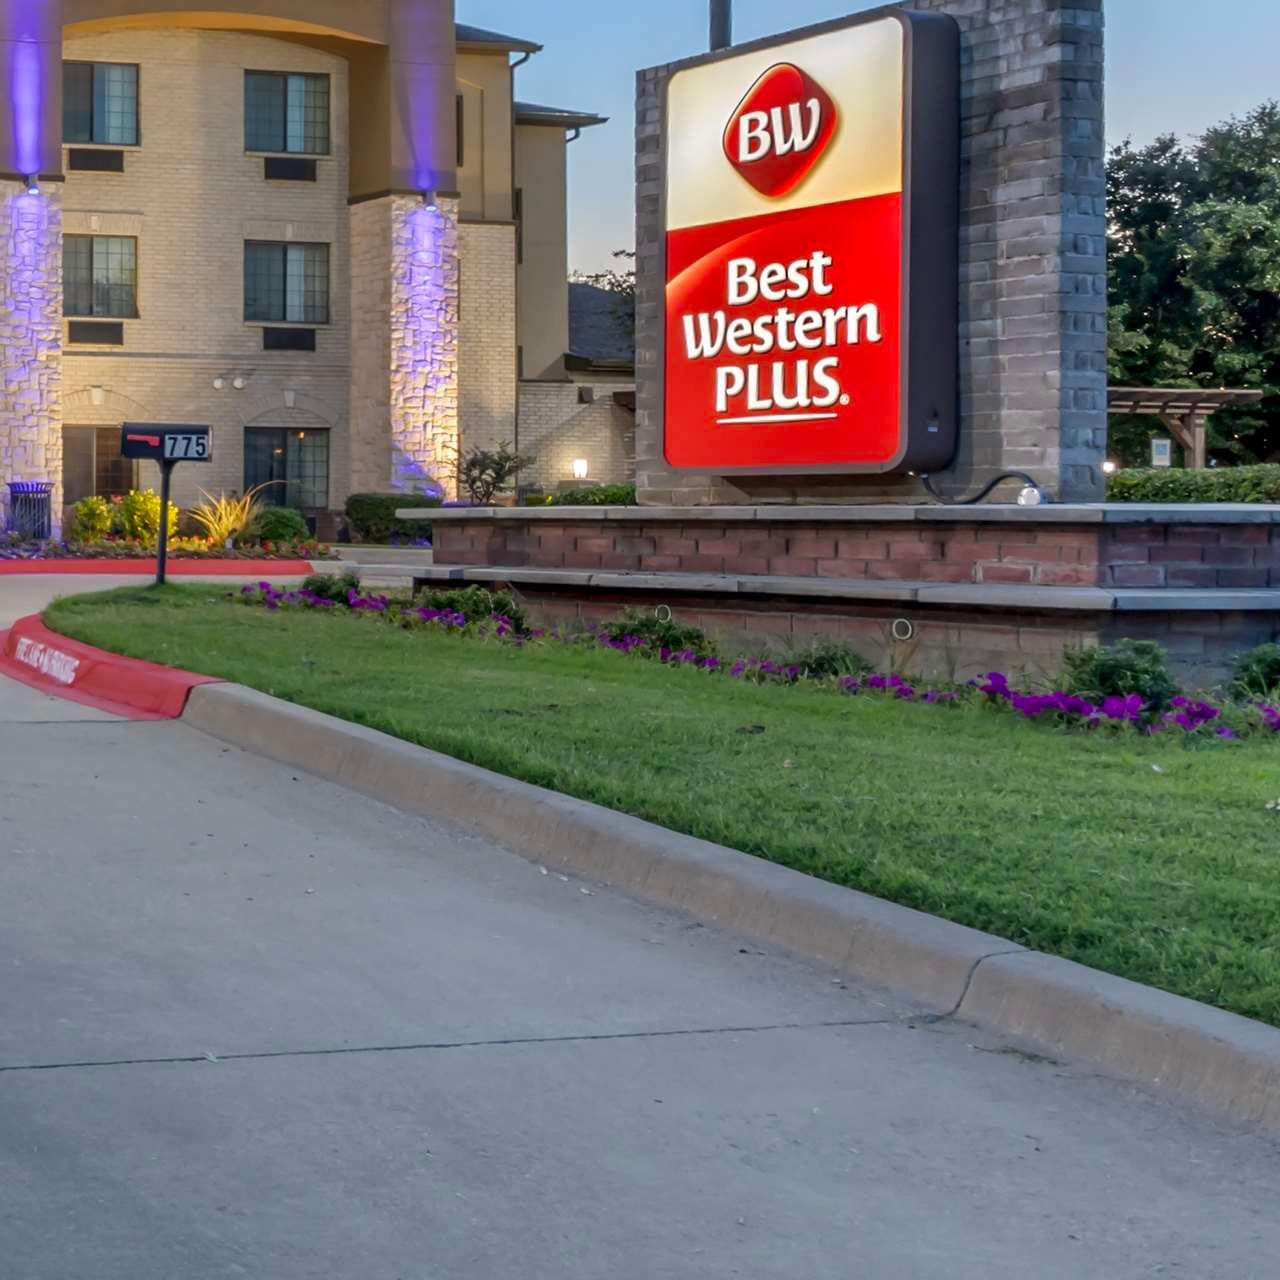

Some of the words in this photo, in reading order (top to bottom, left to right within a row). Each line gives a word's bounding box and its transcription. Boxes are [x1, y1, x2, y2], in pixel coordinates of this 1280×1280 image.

[739, 98, 821, 162] BW
[727, 251, 833, 306] Best
[682, 302, 882, 359] Western
[715, 356, 841, 412] PLUS
[167, 436, 207, 457] 775
